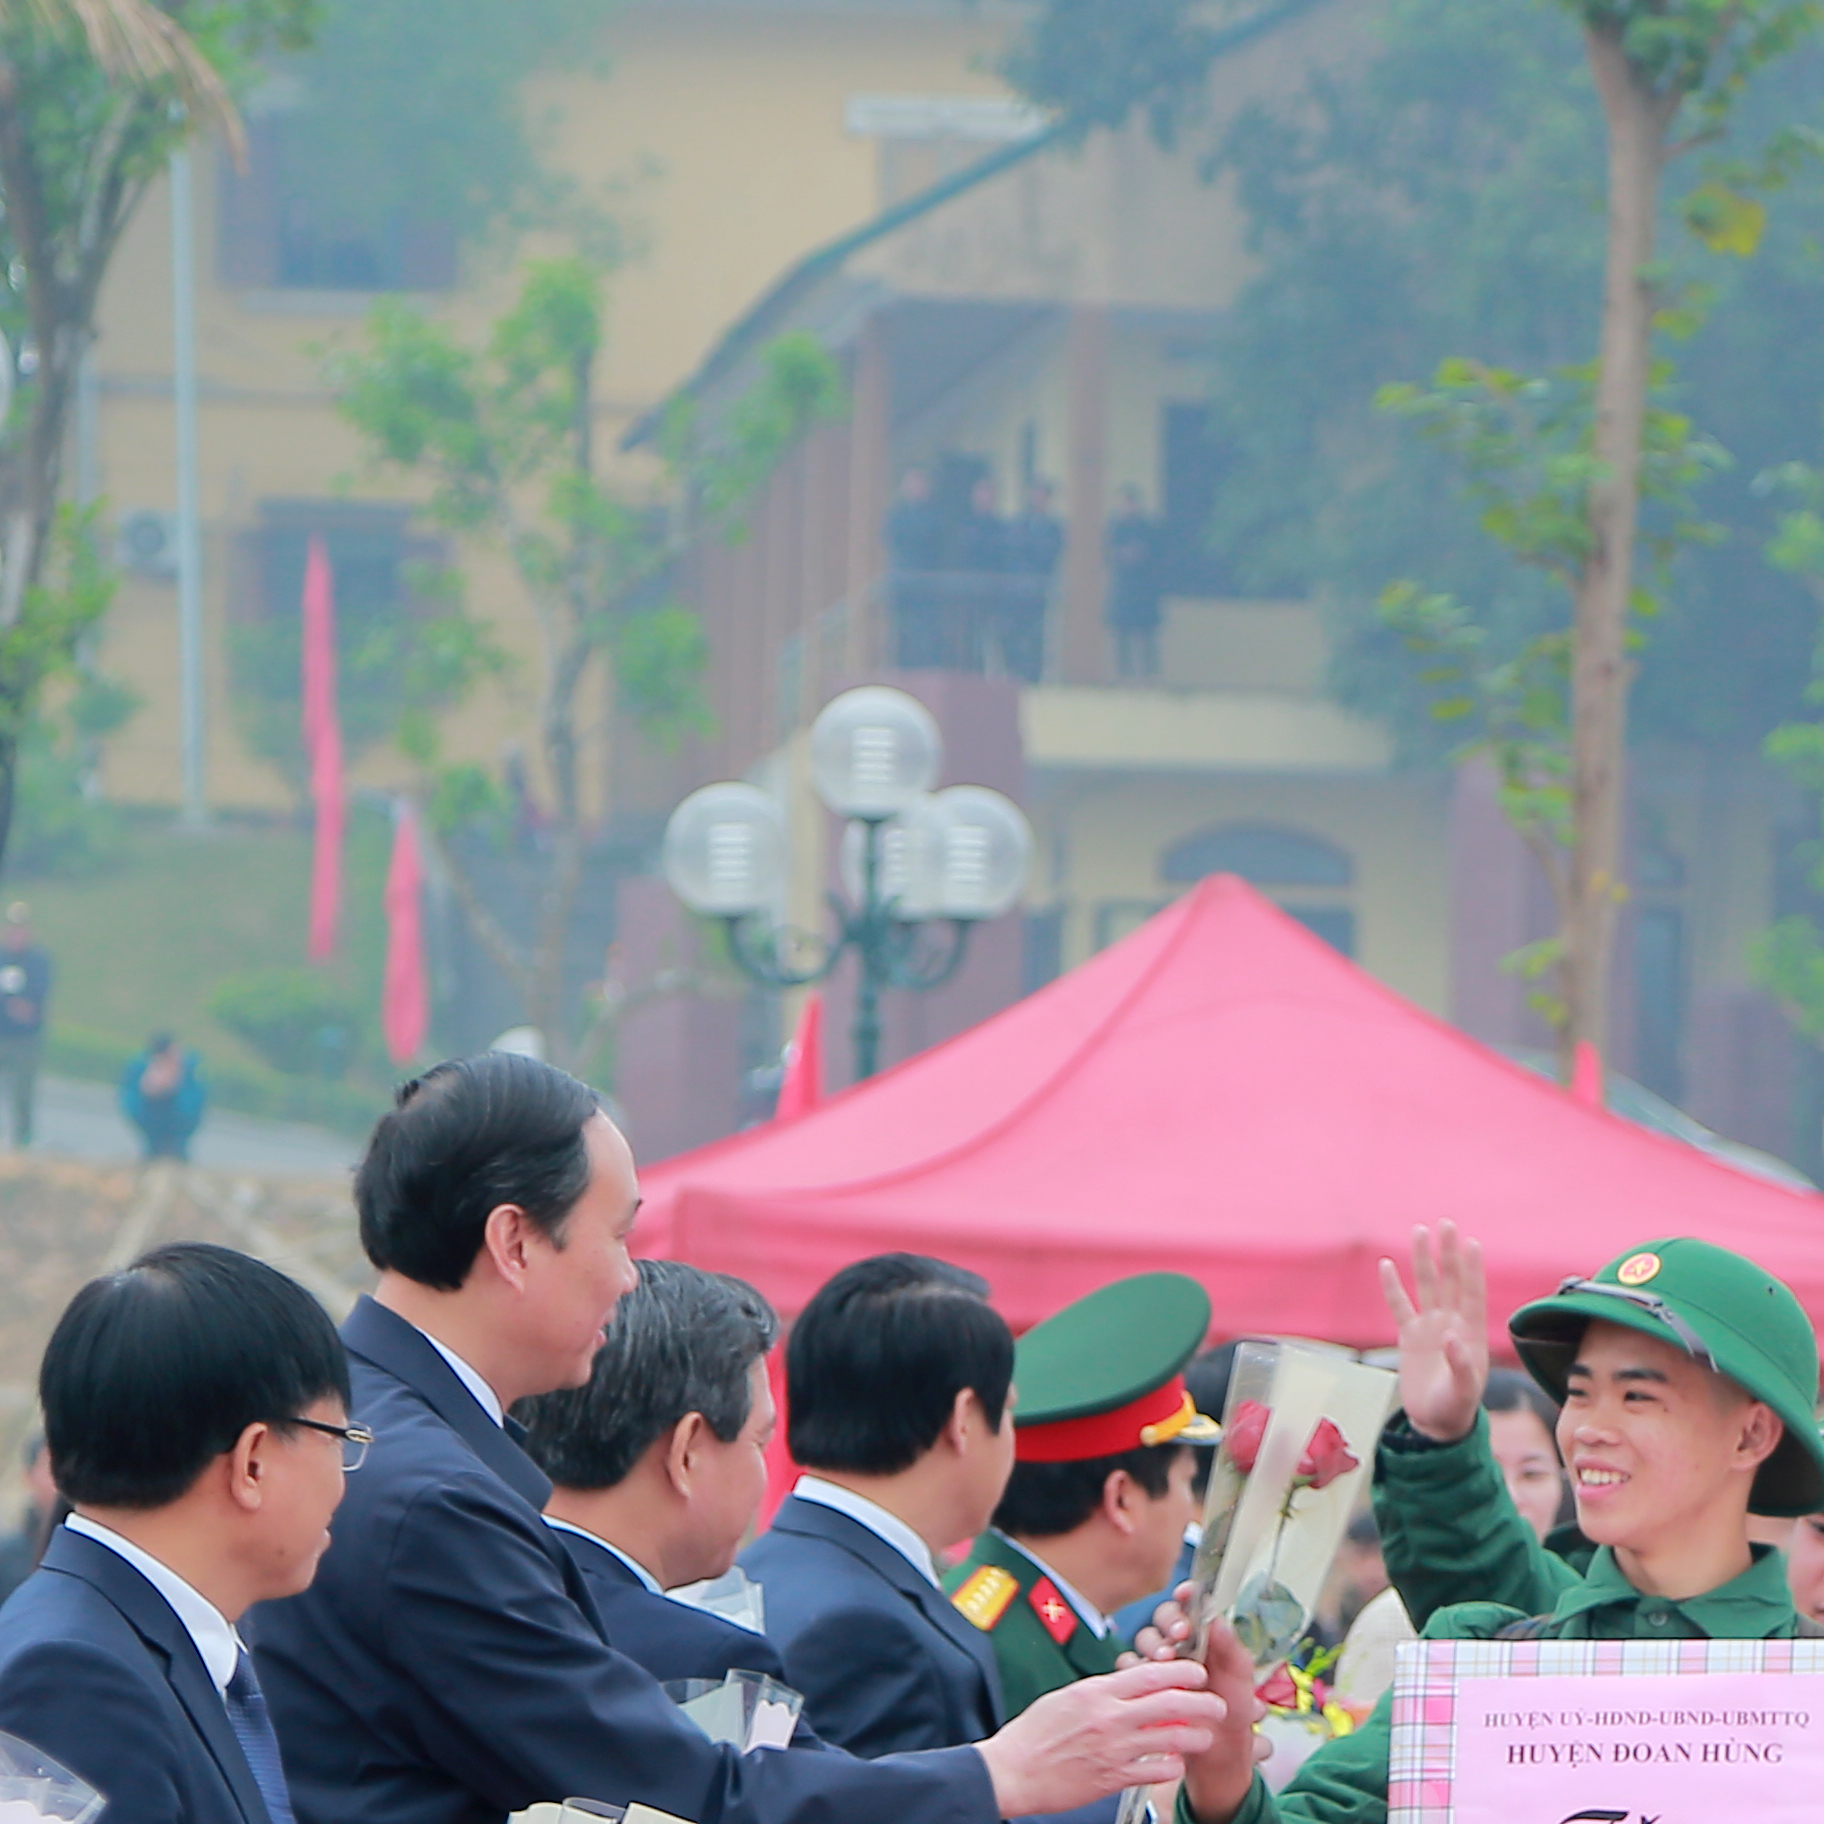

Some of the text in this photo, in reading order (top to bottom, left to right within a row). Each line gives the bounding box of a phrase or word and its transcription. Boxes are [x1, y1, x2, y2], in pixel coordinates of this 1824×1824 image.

[1483, 1713, 1553, 1731] HUYỆN
[1507, 1737, 1785, 1769] HUYỆN ĐOAN HÙNG
